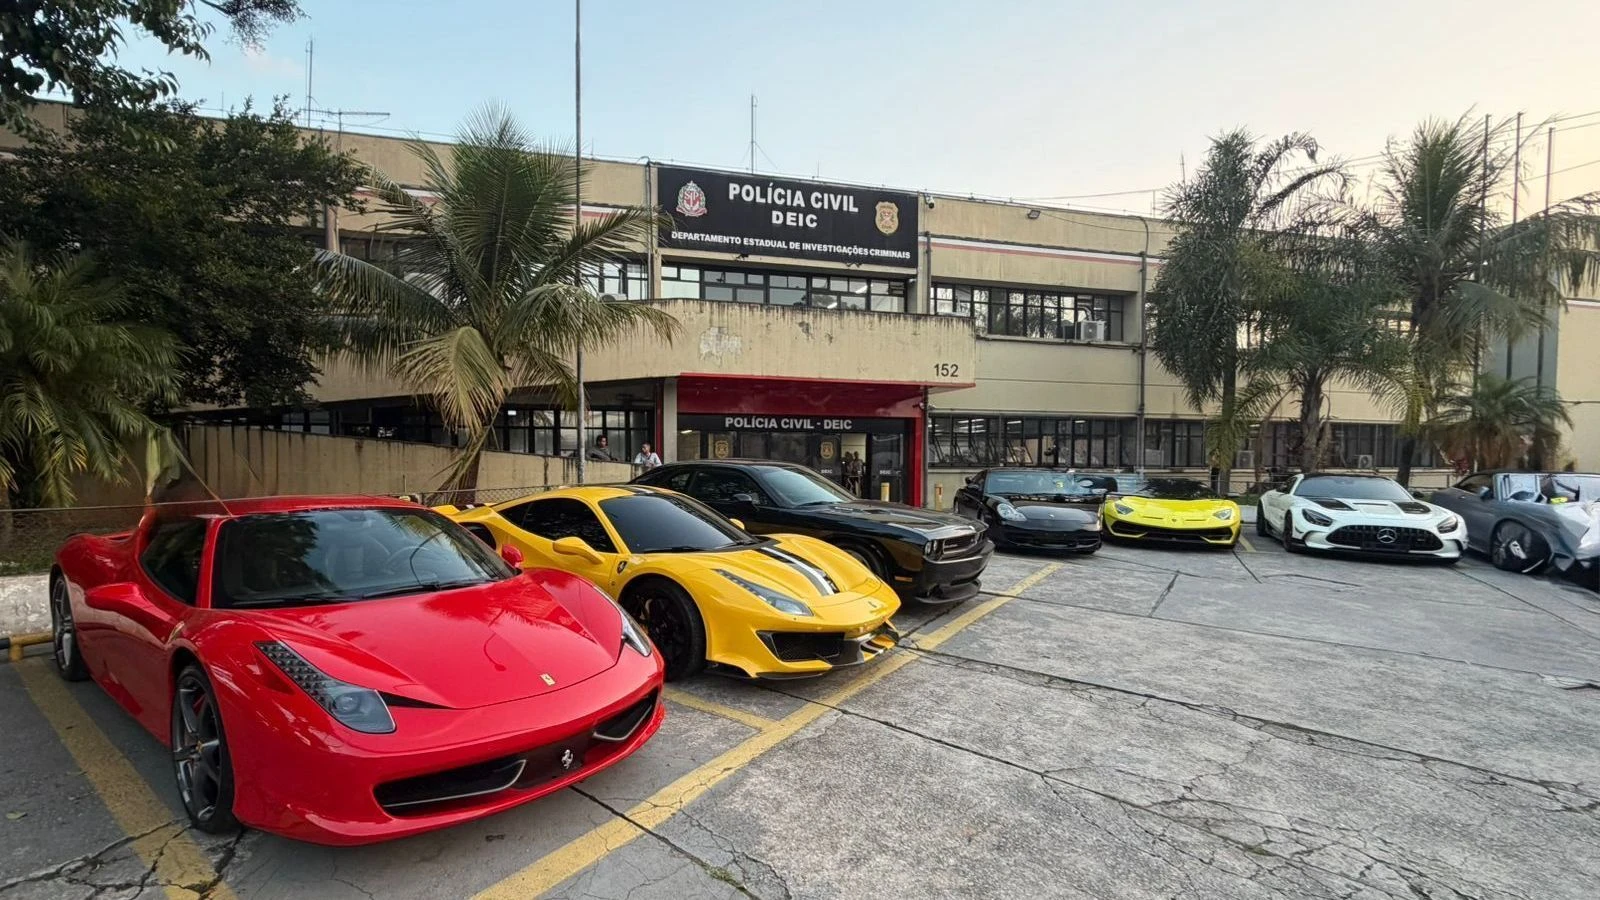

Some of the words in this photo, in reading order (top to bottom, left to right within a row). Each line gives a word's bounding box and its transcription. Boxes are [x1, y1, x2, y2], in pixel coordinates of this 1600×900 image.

[729, 182, 805, 208] POLÍCIA
[810, 191, 859, 213] CIVIL
[771, 210, 818, 228] DEIC
[671, 231, 742, 245] DEPARTAMENTO
[743, 237, 788, 249] ESTADUAL
[789, 241, 801, 250] DE
[802, 242, 869, 256] INVESTIGAÇÕES
[869, 248, 911, 259] CRIMINAIS
[934, 363, 959, 378] 152
[725, 415, 778, 429] POLÍCIA
[781, 418, 815, 430] CIVIL
[823, 419, 852, 430] DEIC
